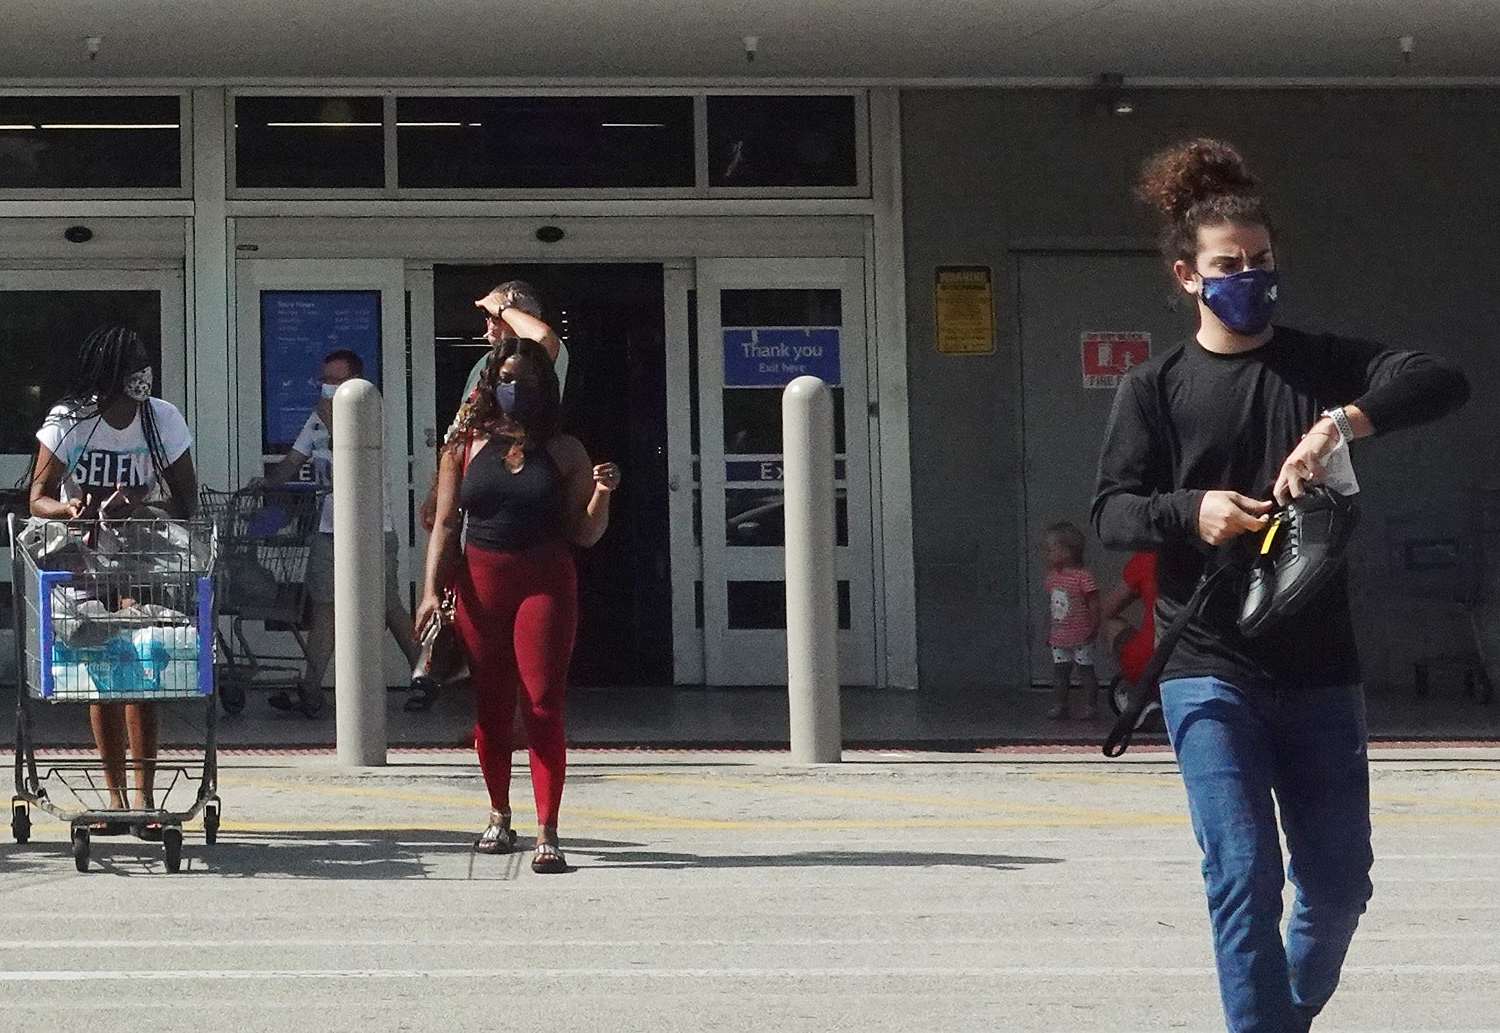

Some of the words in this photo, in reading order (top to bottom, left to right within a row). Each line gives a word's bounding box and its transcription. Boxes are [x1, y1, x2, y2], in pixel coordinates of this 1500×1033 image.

[741, 342, 790, 358] Thank
[793, 346, 823, 361] you
[760, 463, 784, 480] Ex
